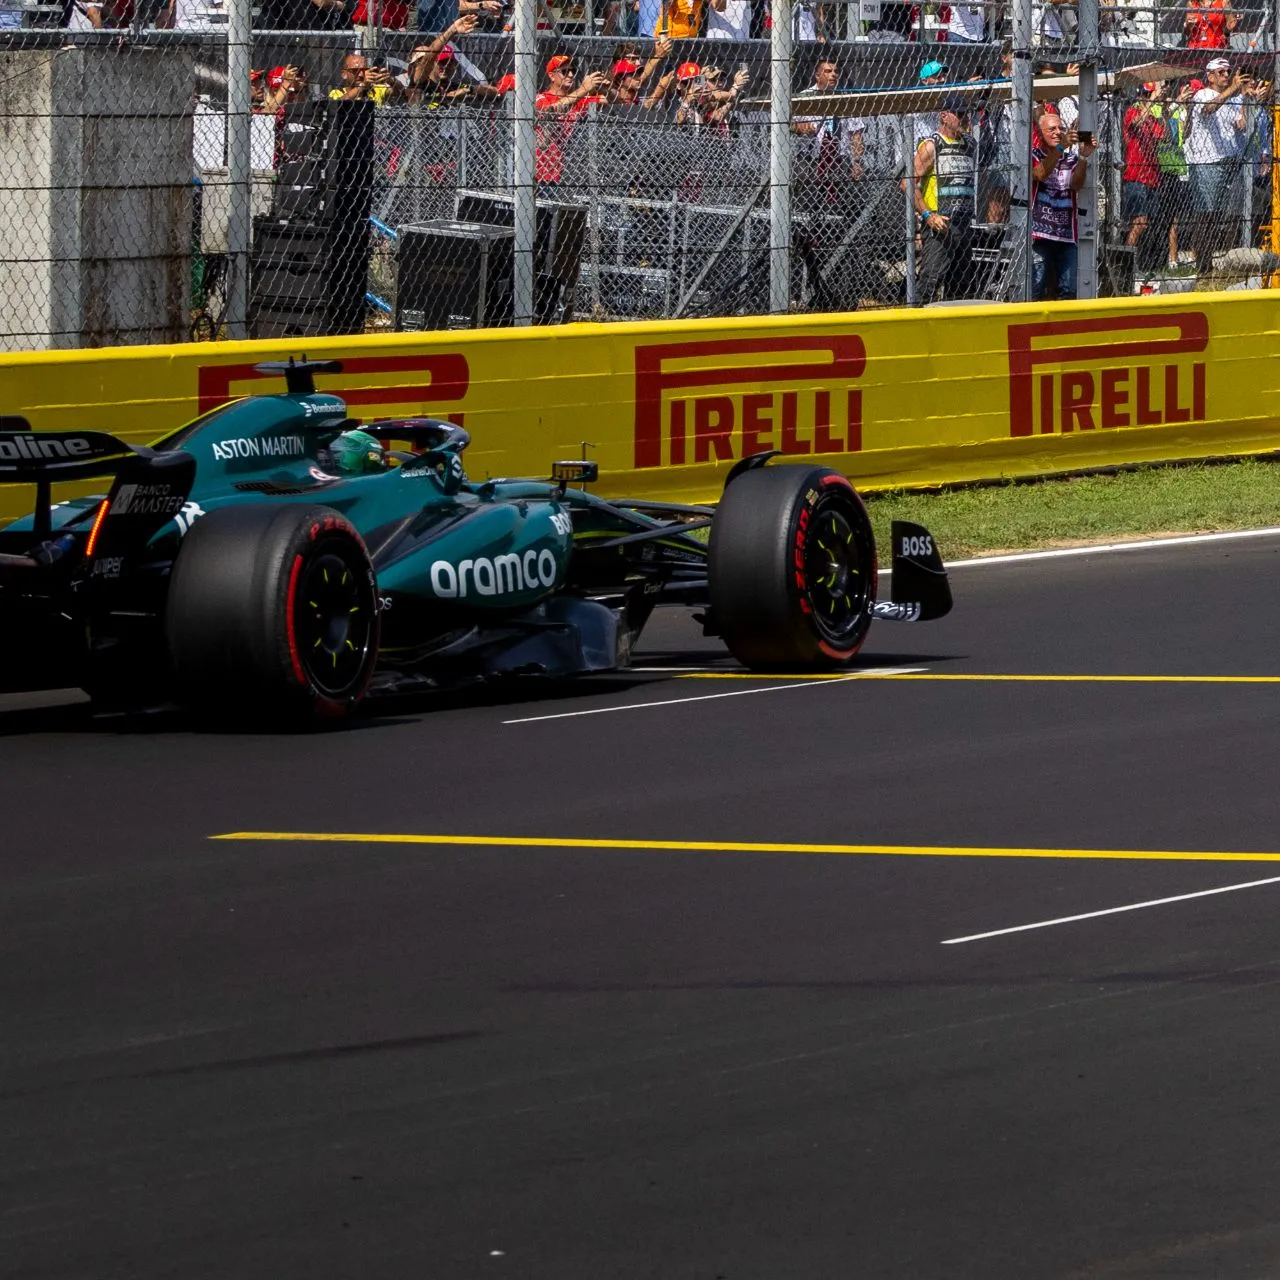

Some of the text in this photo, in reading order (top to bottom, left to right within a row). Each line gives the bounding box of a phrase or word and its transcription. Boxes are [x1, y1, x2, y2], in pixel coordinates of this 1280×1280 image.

[1010, 312, 1211, 439] PIRELLI
[635, 335, 867, 469] PIRELLI
[212, 436, 304, 460] ASTON MARTIN
[136, 484, 170, 495] BANCO
[128, 497, 184, 513] MASTER
[902, 535, 932, 556] BOSS
[430, 548, 556, 597] aramco
